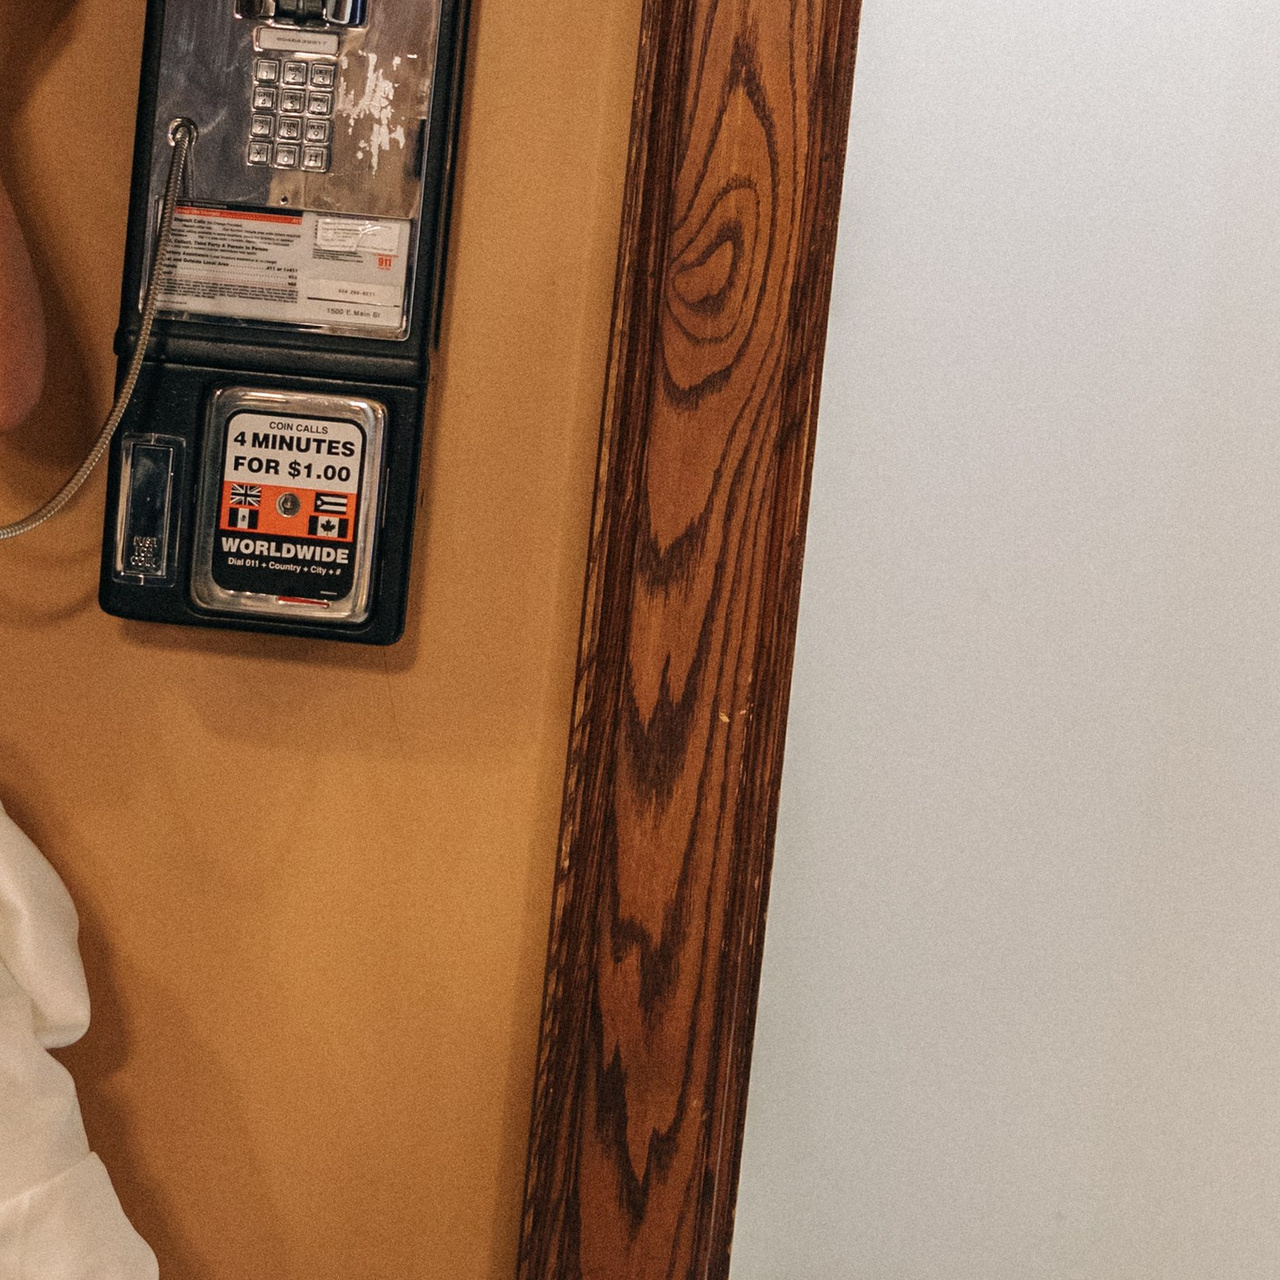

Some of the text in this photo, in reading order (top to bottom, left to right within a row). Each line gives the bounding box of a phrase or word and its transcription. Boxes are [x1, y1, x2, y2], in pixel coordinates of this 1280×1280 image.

[378, 257, 392, 267] 911
[269, 421, 328, 434] COIN CALLS
[234, 432, 355, 457] 4 MINUTES
[234, 456, 351, 482] FOR $1.00
[222, 537, 349, 564] WORLDWIDE
[228, 557, 244, 566] Dial
[245, 558, 259, 568] 011
[269, 561, 301, 573] Country
[310, 565, 327, 576] City
